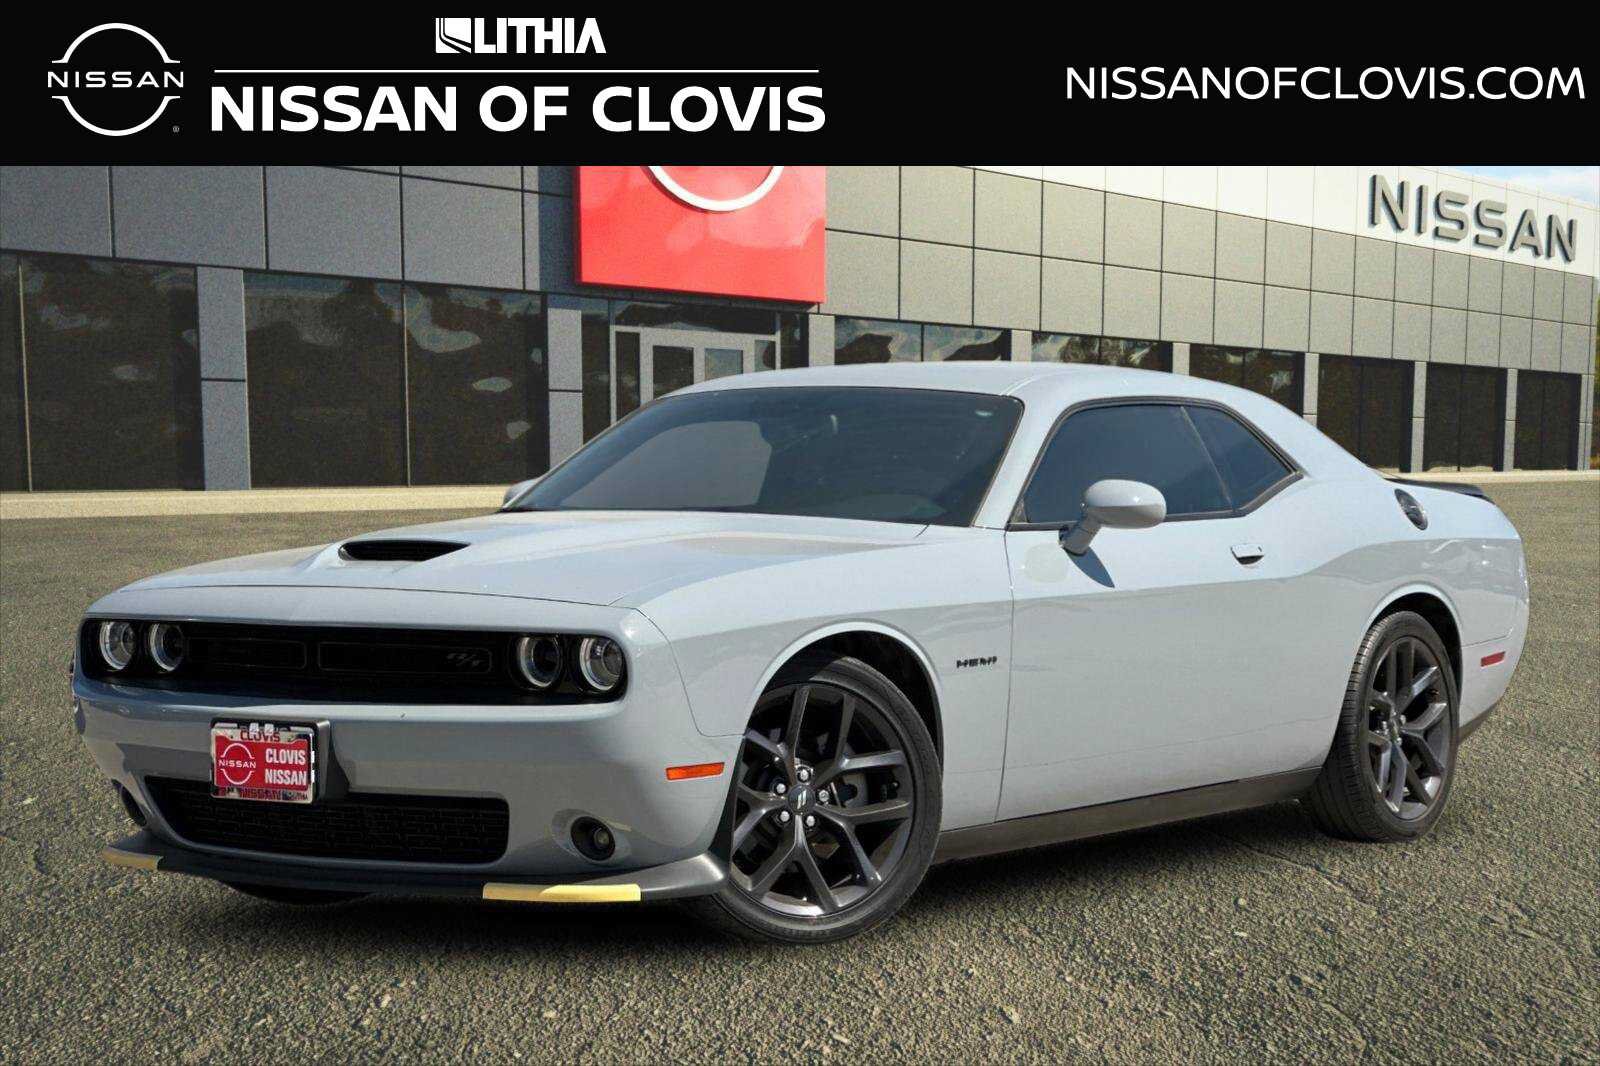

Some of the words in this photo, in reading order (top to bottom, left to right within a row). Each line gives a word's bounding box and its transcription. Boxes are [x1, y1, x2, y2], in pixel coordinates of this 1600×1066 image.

[1369, 174, 1577, 262] NISSAN
[218, 759, 257, 768] NISSAN
[265, 748, 306, 766] CLOVIS
[264, 768, 307, 786] NISSAN
